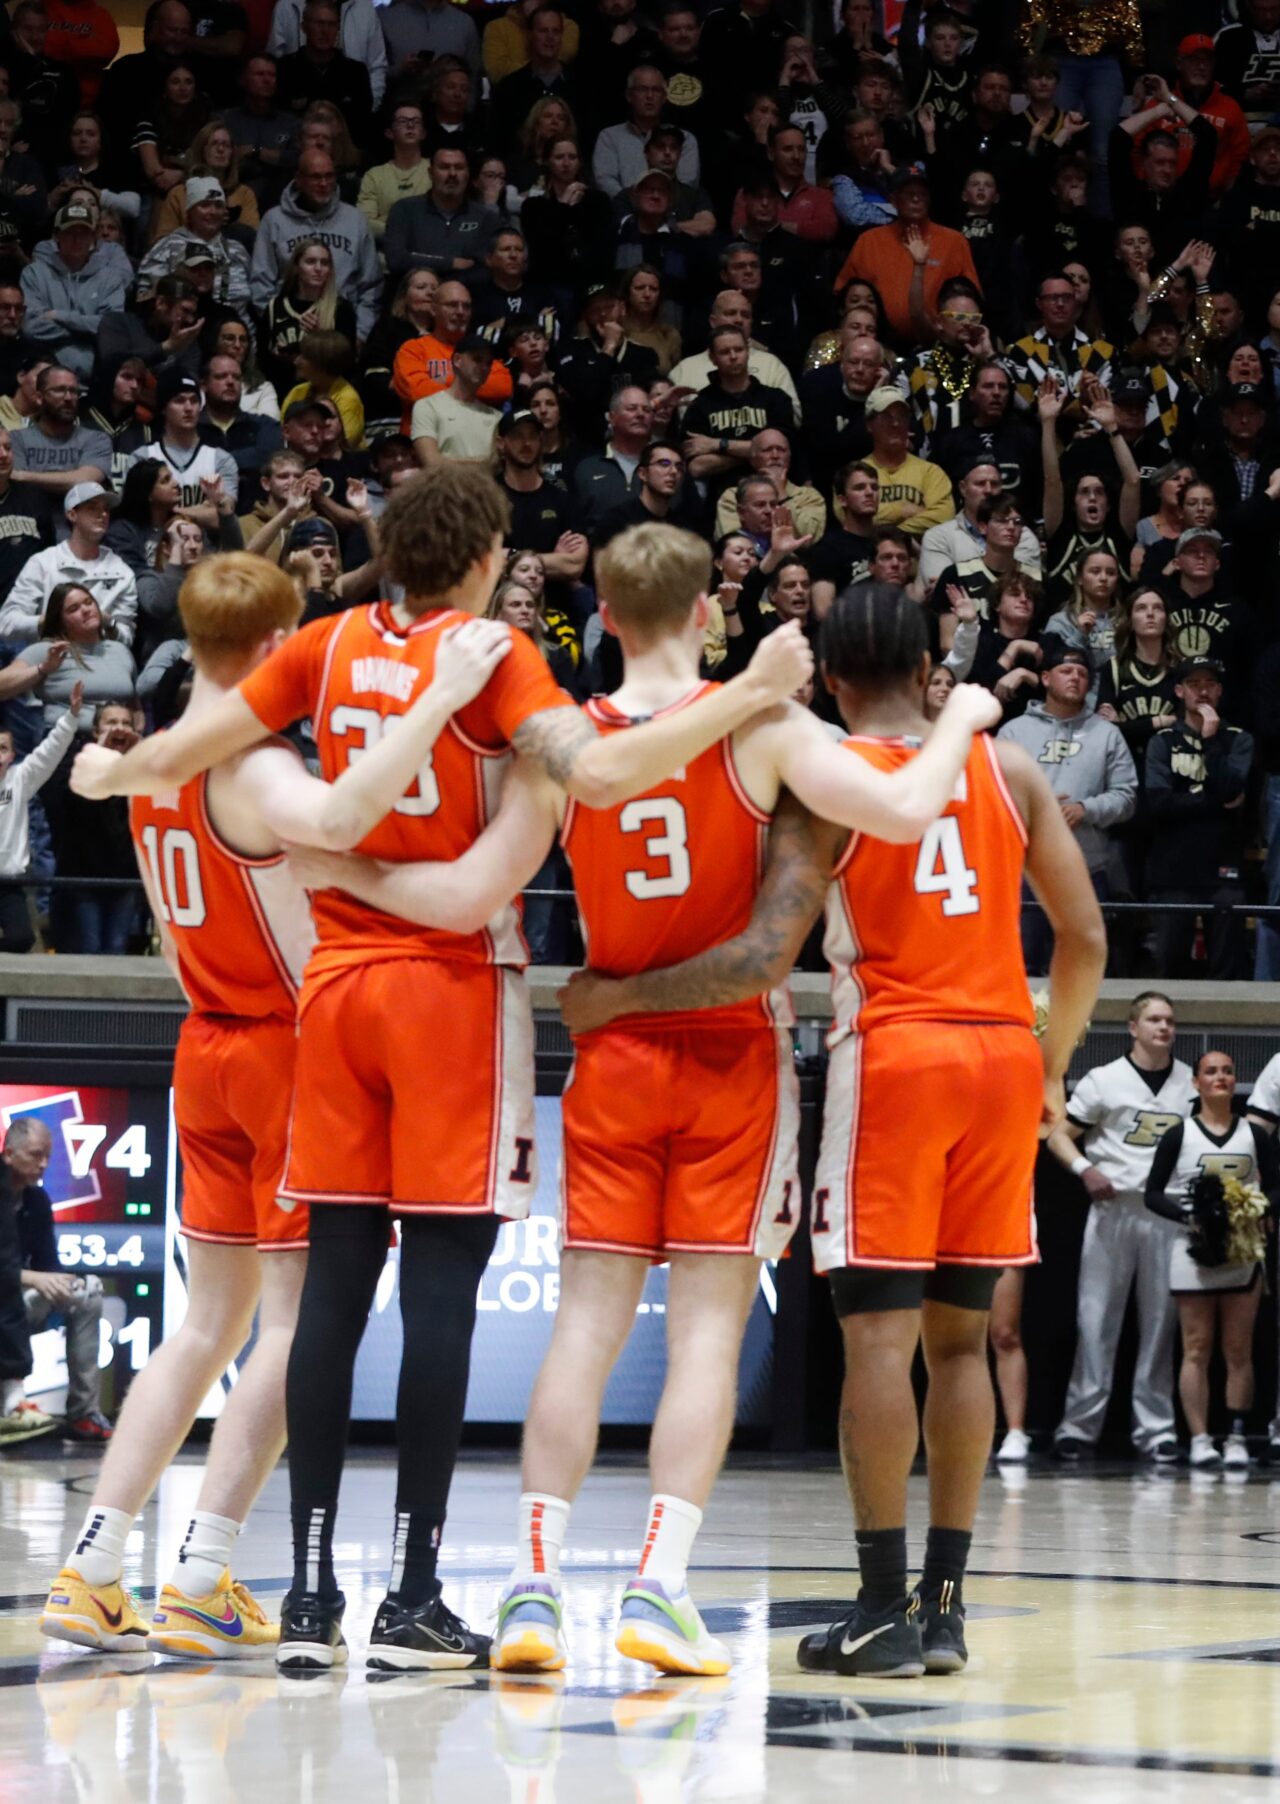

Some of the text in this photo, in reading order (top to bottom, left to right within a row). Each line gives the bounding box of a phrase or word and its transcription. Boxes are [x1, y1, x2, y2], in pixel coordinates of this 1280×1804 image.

[880, 483, 924, 504] RDUE
[1168, 607, 1231, 632] URDUE
[1119, 696, 1174, 721] URDU
[619, 796, 692, 901] 3
[913, 814, 980, 917] 4
[142, 825, 206, 928] 10
[67, 1125, 151, 1178] 74
[58, 1235, 145, 1266] 53.4
